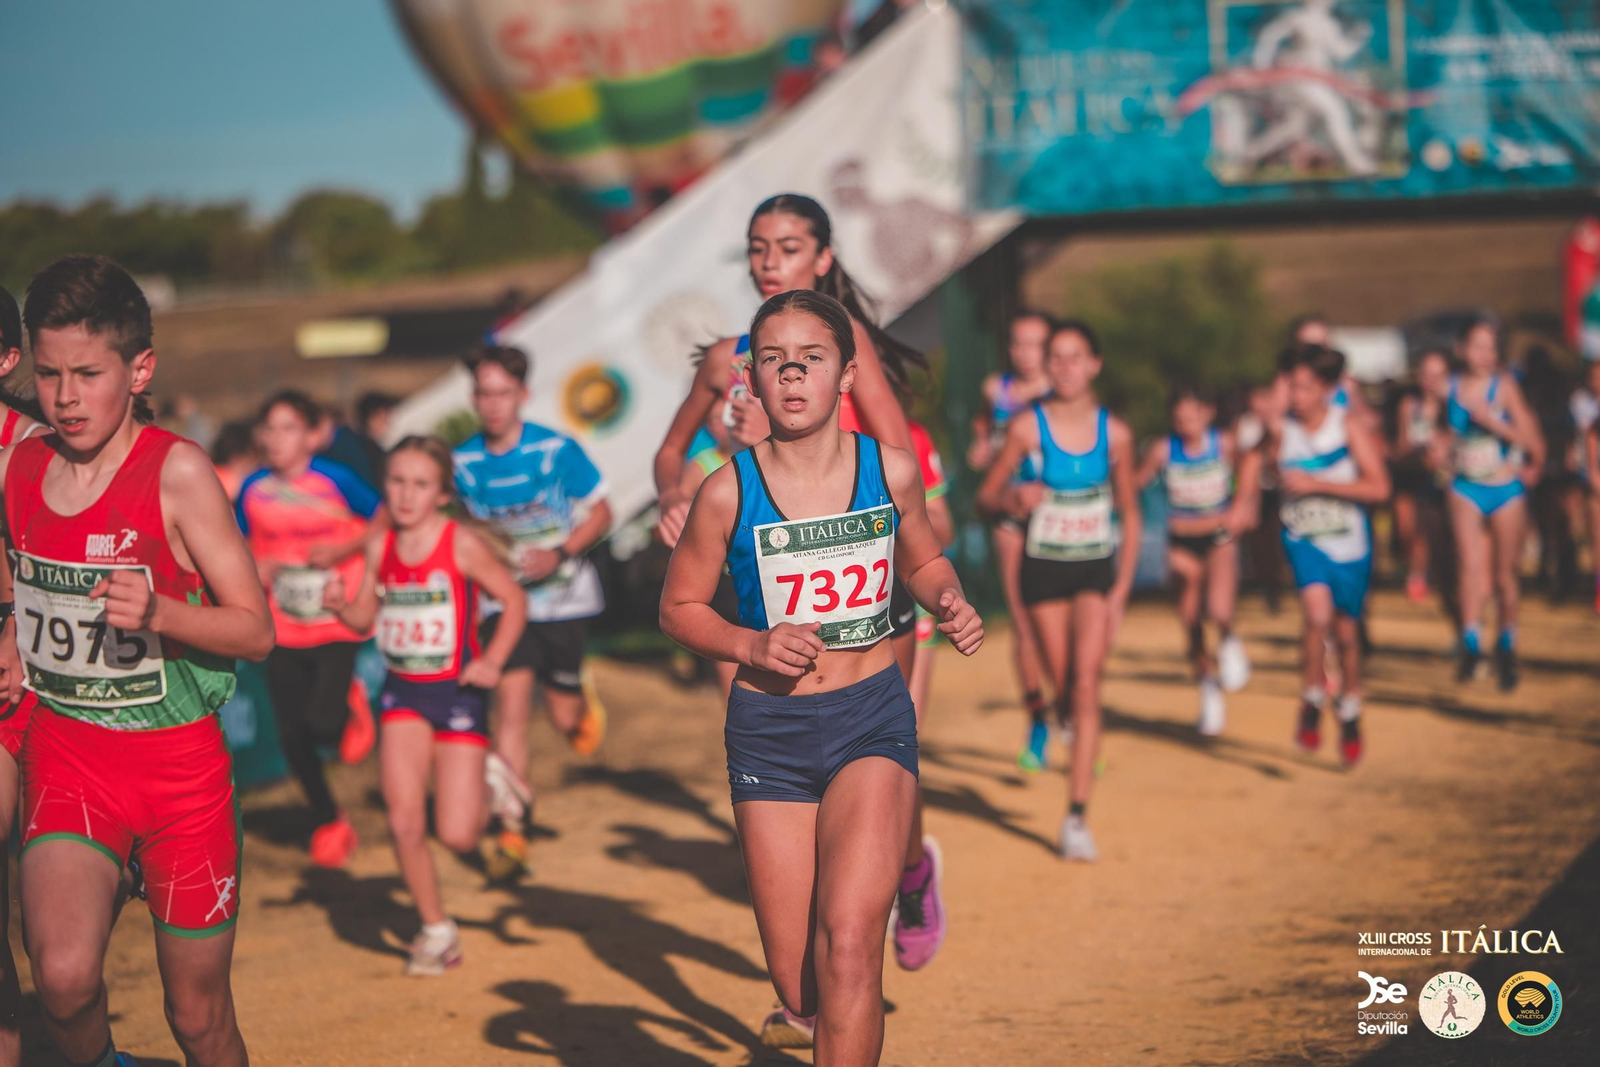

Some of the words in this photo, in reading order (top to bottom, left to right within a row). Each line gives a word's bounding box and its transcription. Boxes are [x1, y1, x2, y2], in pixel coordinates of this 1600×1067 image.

[800, 519, 867, 541] ITÁLICA
[792, 551, 816, 559] AITANA
[816, 545, 846, 556] GALLEGO
[826, 551, 855, 560] GALOSPORT
[39, 565, 103, 588] ITÁLICA
[776, 558, 889, 616] 7322
[25, 608, 148, 664] 7975
